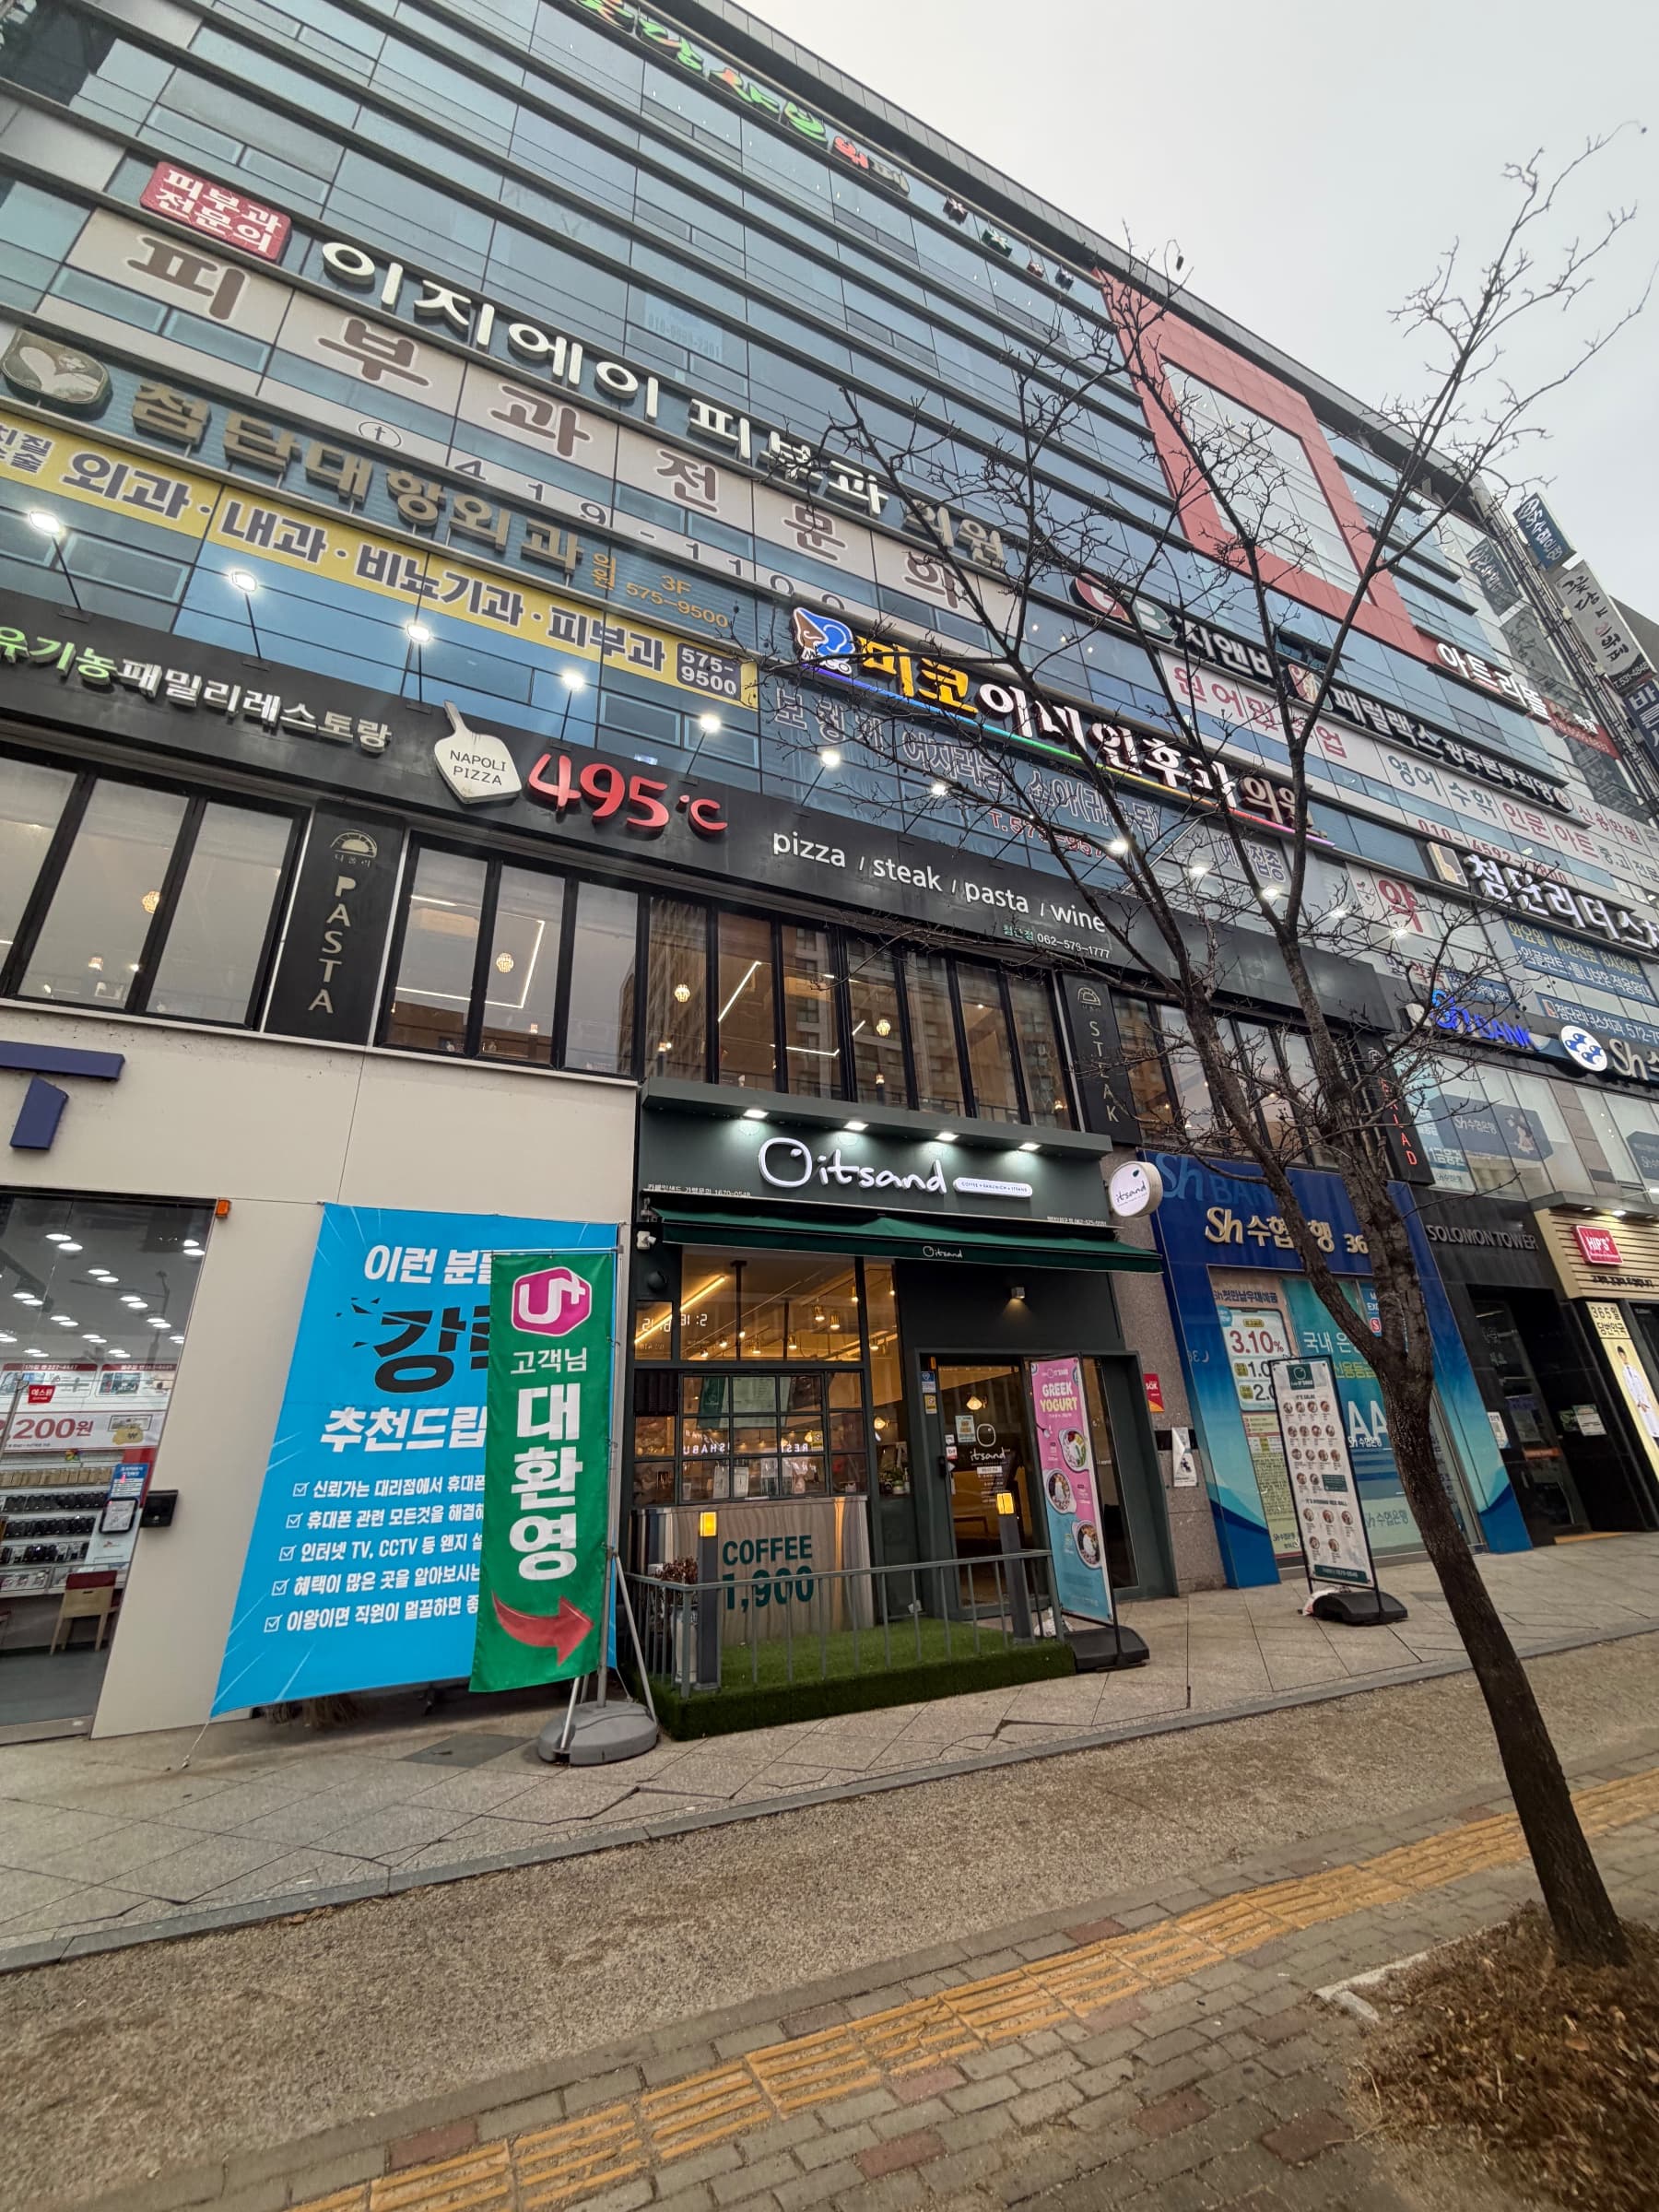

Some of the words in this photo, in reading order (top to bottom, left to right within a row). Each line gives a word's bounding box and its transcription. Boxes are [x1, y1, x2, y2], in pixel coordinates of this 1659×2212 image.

[163, 169, 283, 233] 피부과
[155, 188, 275, 253] 전문의
[904, 500, 1006, 568] 의원
[661, 575, 691, 594] 3F
[626, 582, 728, 628] 575-9500
[0, 626, 119, 686] 유기농
[118, 657, 393, 759] 패밀리레스토랑
[681, 666, 737, 695] 9500
[1334, 687, 1443, 759] 패럴랙스
[449, 749, 507, 772] NAPOLI
[453, 765, 503, 786] PIZZA
[1387, 755, 1441, 797] 영어
[1502, 801, 1550, 842] 인문
[1554, 823, 1600, 860] 아트
[772, 831, 847, 868] pizza
[873, 857, 942, 894] steak
[965, 879, 1030, 915] pasta
[1050, 902, 1107, 934] wine
[1377, 878, 1425, 934] 약
[308, 876, 357, 1014] PASTA
[1427, 1224, 1496, 1246] SOLOMON
[1495, 1230, 1540, 1252] TOWER
[364, 1244, 438, 1284] 이런
[443, 1249, 491, 1285] 분
[1302, 1331, 1334, 1355] 국내
[510, 1347, 589, 1375] 고객님
[1042, 1382, 1073, 1398] GREEK
[1039, 1396, 1078, 1414] YOGURT
[970, 1446, 1006, 1463] itsand
[312, 1479, 369, 1499] 신뢰가는
[374, 1476, 443, 1497] 대리점에서
[306, 1509, 352, 1530] 휴대폰
[356, 1508, 384, 1528] 관련
[388, 1504, 444, 1525] 모든것을
[300, 1540, 347, 1562] 인터넷
[351, 1540, 374, 1560] TV,
[378, 1537, 418, 1558] CCTV
[421, 1535, 436, 1555] 등
[722, 1535, 813, 1566] COFFEE
[293, 1573, 342, 1596] 혜택이
[346, 1571, 376, 1593] 많은
[381, 1568, 410, 1590] 곳을
[286, 1606, 350, 1632] 이왕이면
[355, 1602, 400, 1625] 직원이
[405, 1595, 462, 1620] 멀끔하면
